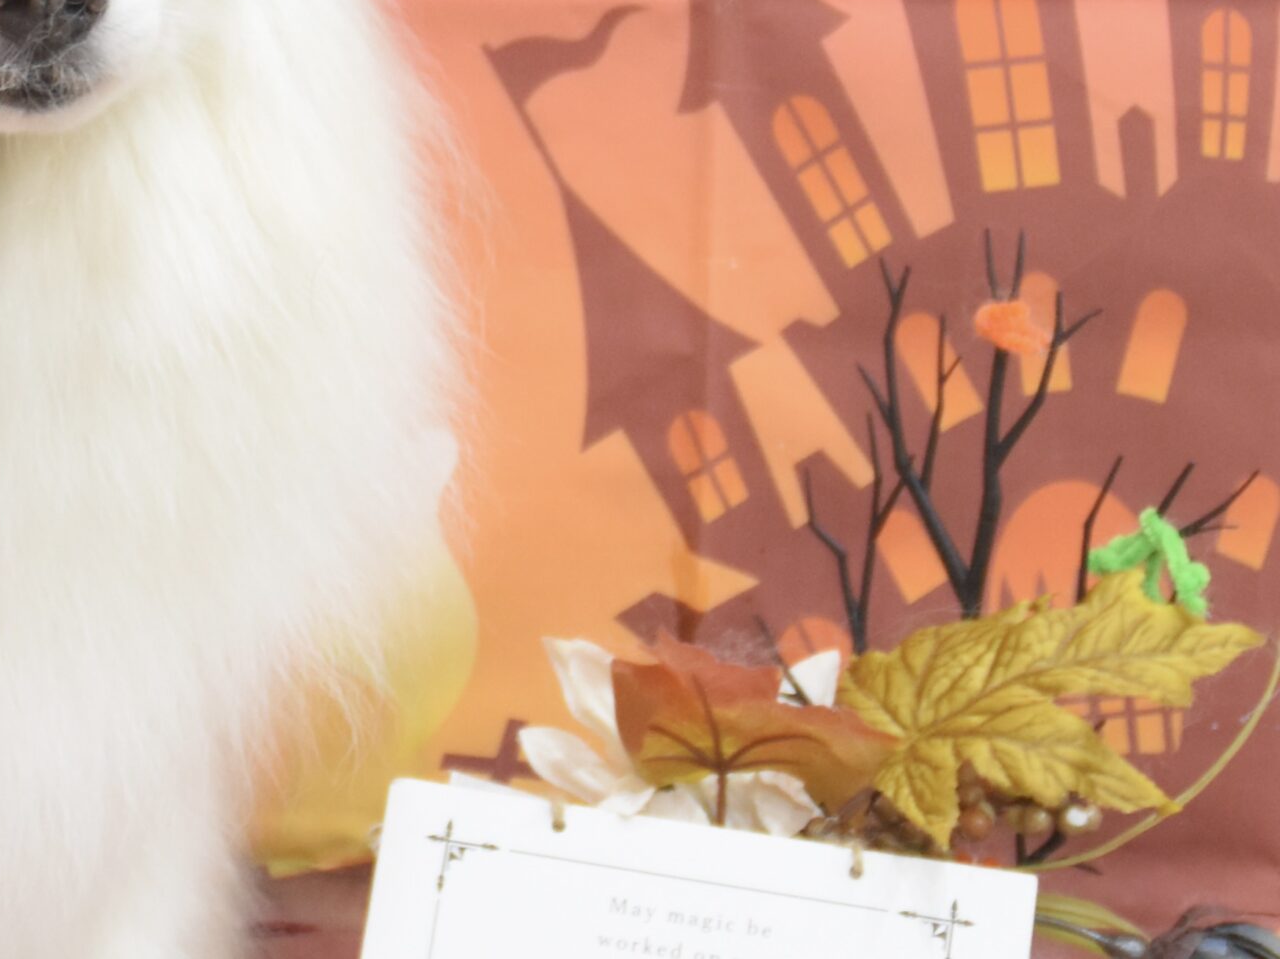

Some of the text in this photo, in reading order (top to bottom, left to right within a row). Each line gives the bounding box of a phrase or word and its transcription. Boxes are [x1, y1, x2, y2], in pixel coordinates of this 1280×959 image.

[608, 896, 773, 939] May magic be
[597, 933, 683, 959] worked
